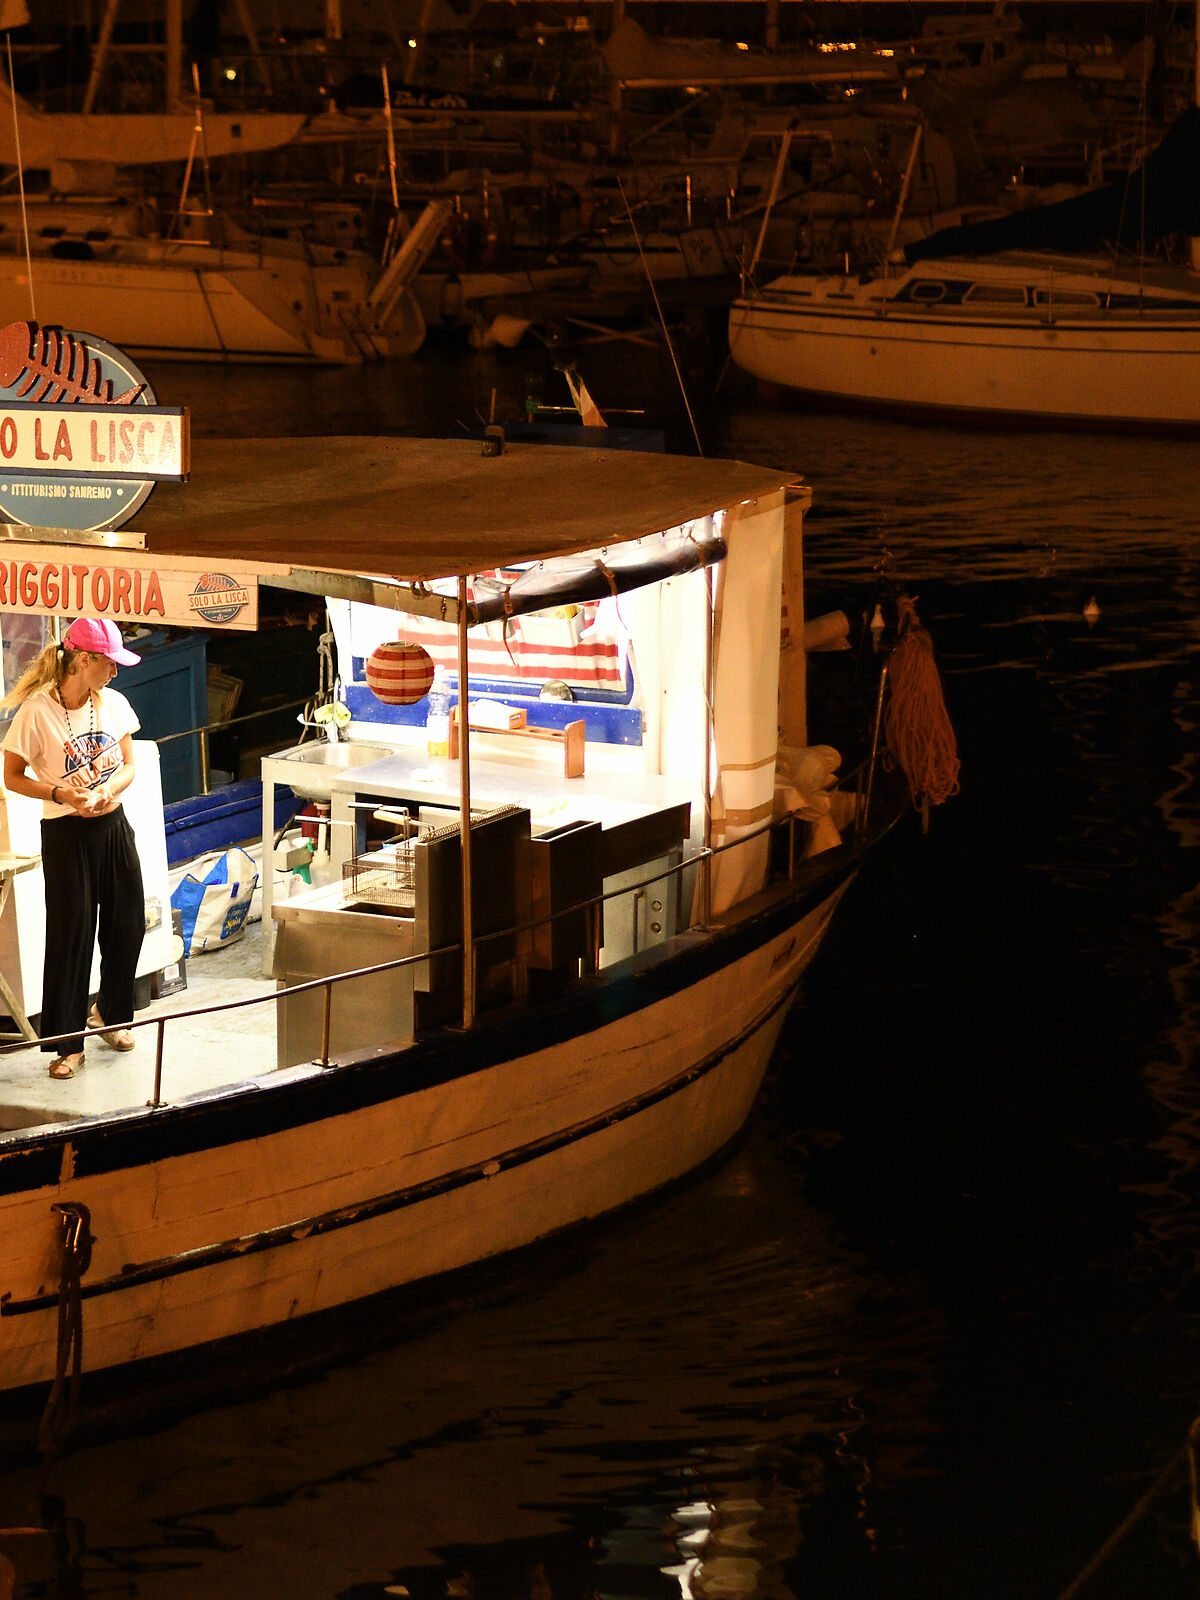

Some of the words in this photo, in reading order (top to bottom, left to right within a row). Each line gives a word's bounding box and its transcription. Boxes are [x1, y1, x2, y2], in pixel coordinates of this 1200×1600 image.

[34, 417, 73, 462] LA
[90, 419, 177, 465] LISCA
[10, 483, 68, 498] ITTITURISMO
[69, 485, 113, 500] SANREMO
[189, 595, 209, 608] SOLO
[211, 594, 222, 605] LA
[225, 591, 248, 604] LISCA
[101, 747, 121, 769] LISC
